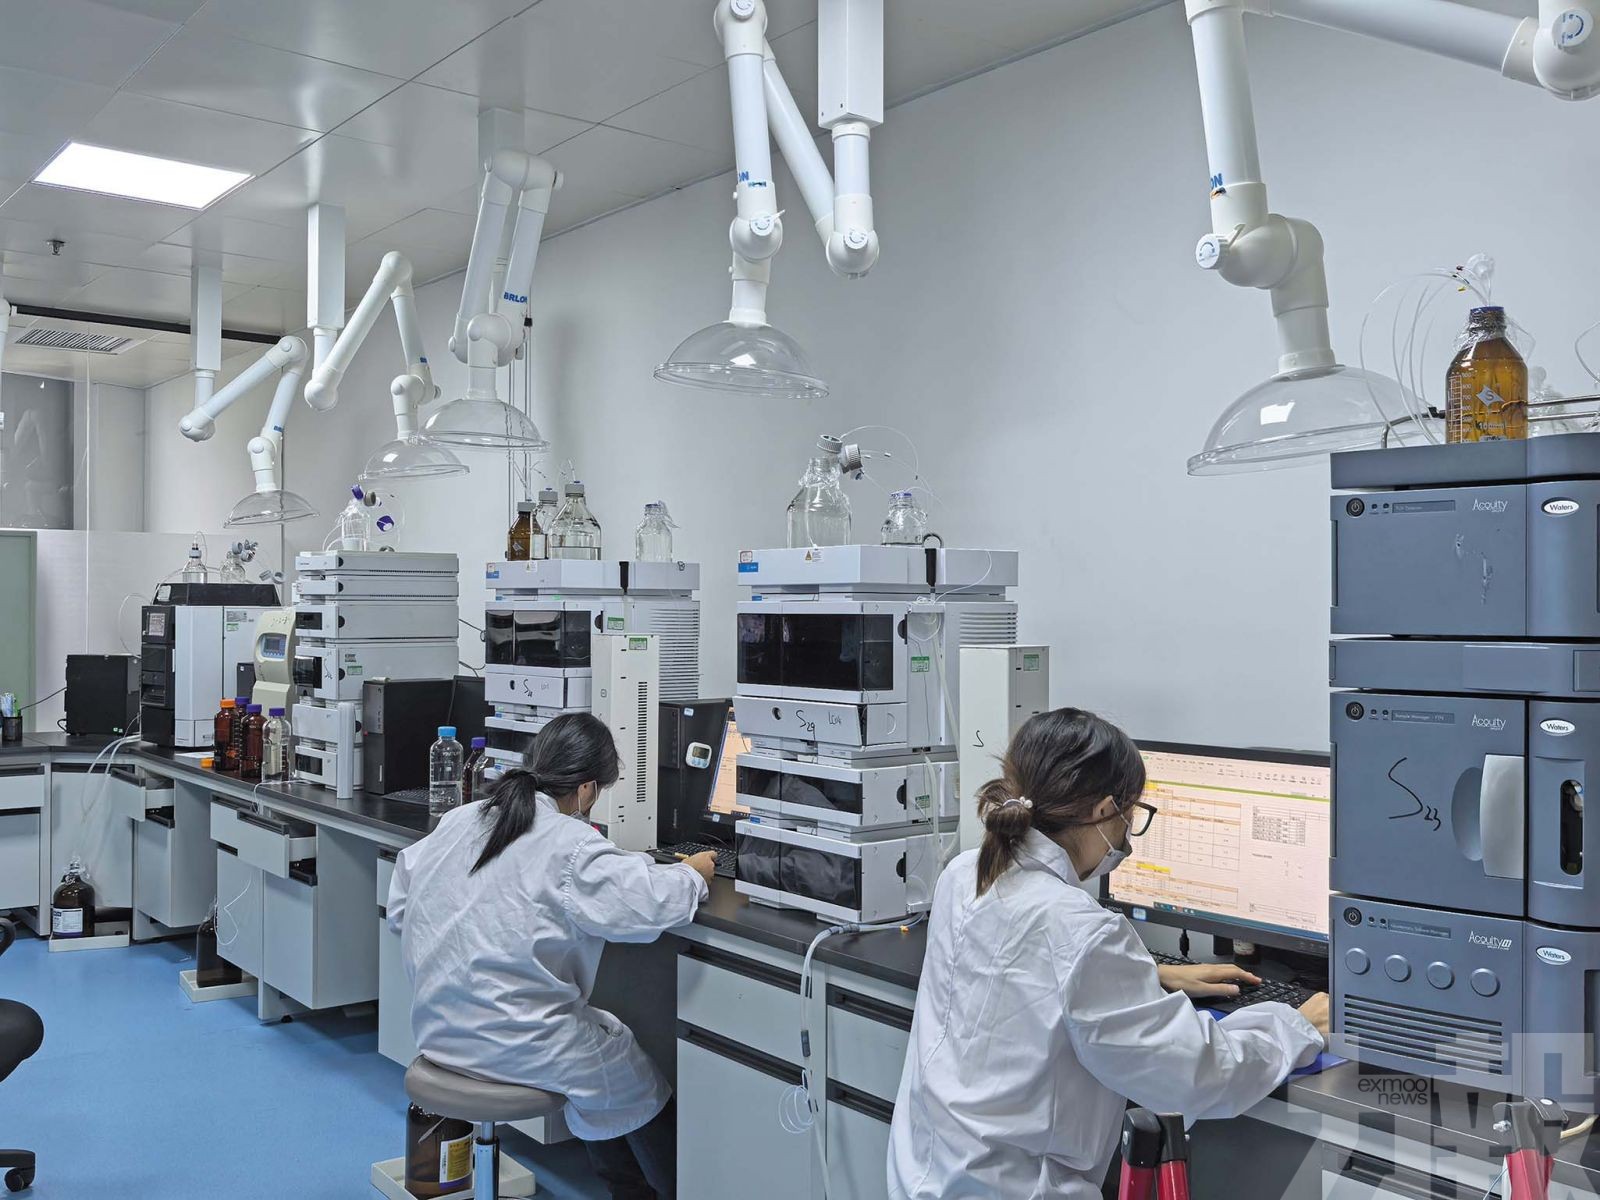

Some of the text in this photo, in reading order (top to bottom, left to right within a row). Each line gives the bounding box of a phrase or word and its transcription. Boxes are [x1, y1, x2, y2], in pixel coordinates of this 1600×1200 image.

[1549, 503, 1573, 511] Waters
[1546, 723, 1569, 731] Waters
[1543, 949, 1566, 960] Waters
